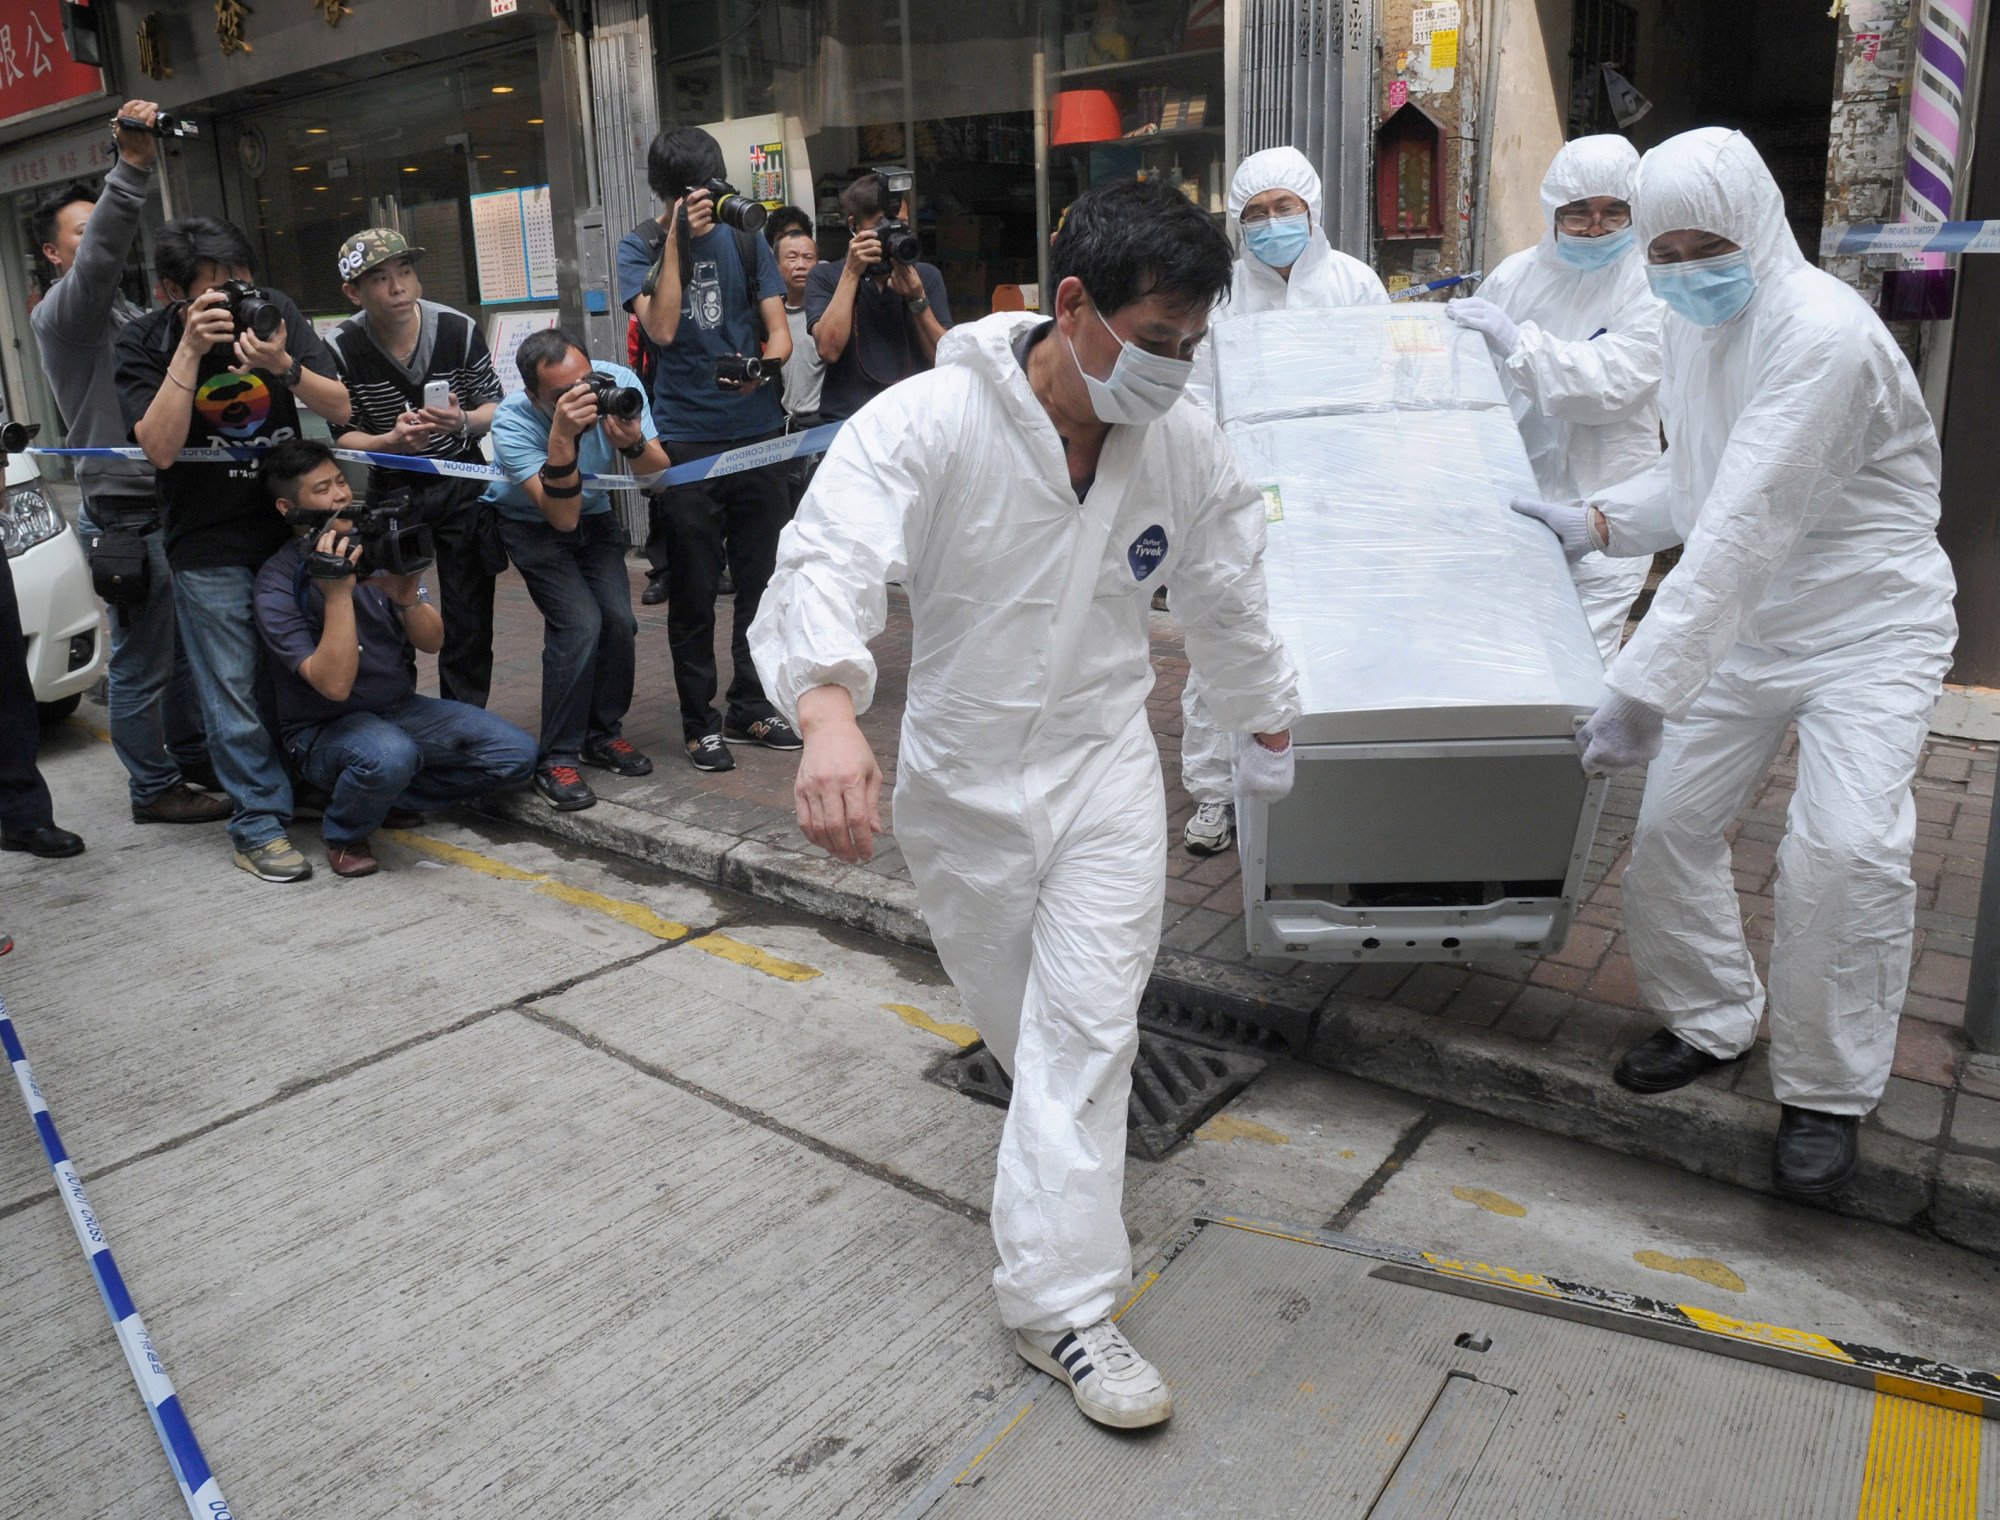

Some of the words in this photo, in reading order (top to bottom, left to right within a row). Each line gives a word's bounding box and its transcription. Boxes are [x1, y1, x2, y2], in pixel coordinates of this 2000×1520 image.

[0, 10, 69, 90] 限公
[443, 461, 487, 474] CORDON
[1135, 544, 1163, 557] Tyvek
[81, 1209, 106, 1243] CROSS
